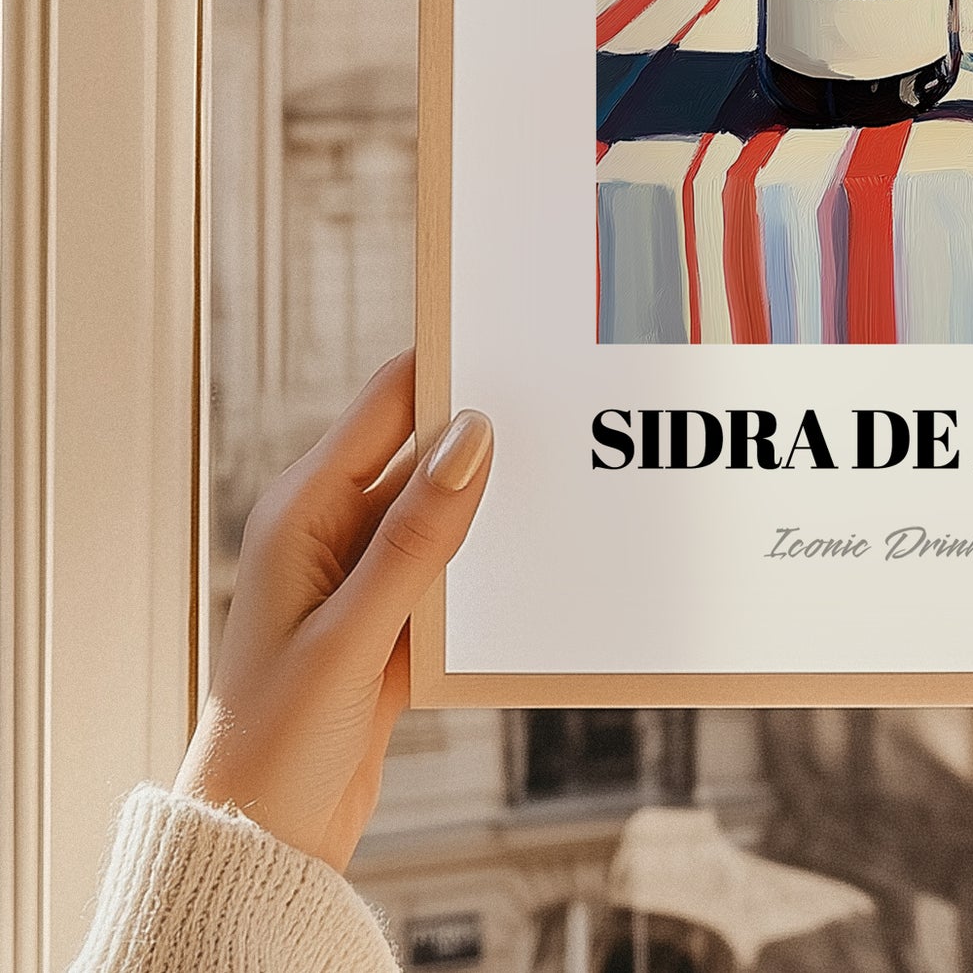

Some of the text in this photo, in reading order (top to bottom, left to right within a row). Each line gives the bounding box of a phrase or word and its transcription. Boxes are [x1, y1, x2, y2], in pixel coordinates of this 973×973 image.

[591, 408, 840, 471] SIDRA
[851, 409, 960, 470] DE
[764, 527, 872, 560] Iconic
